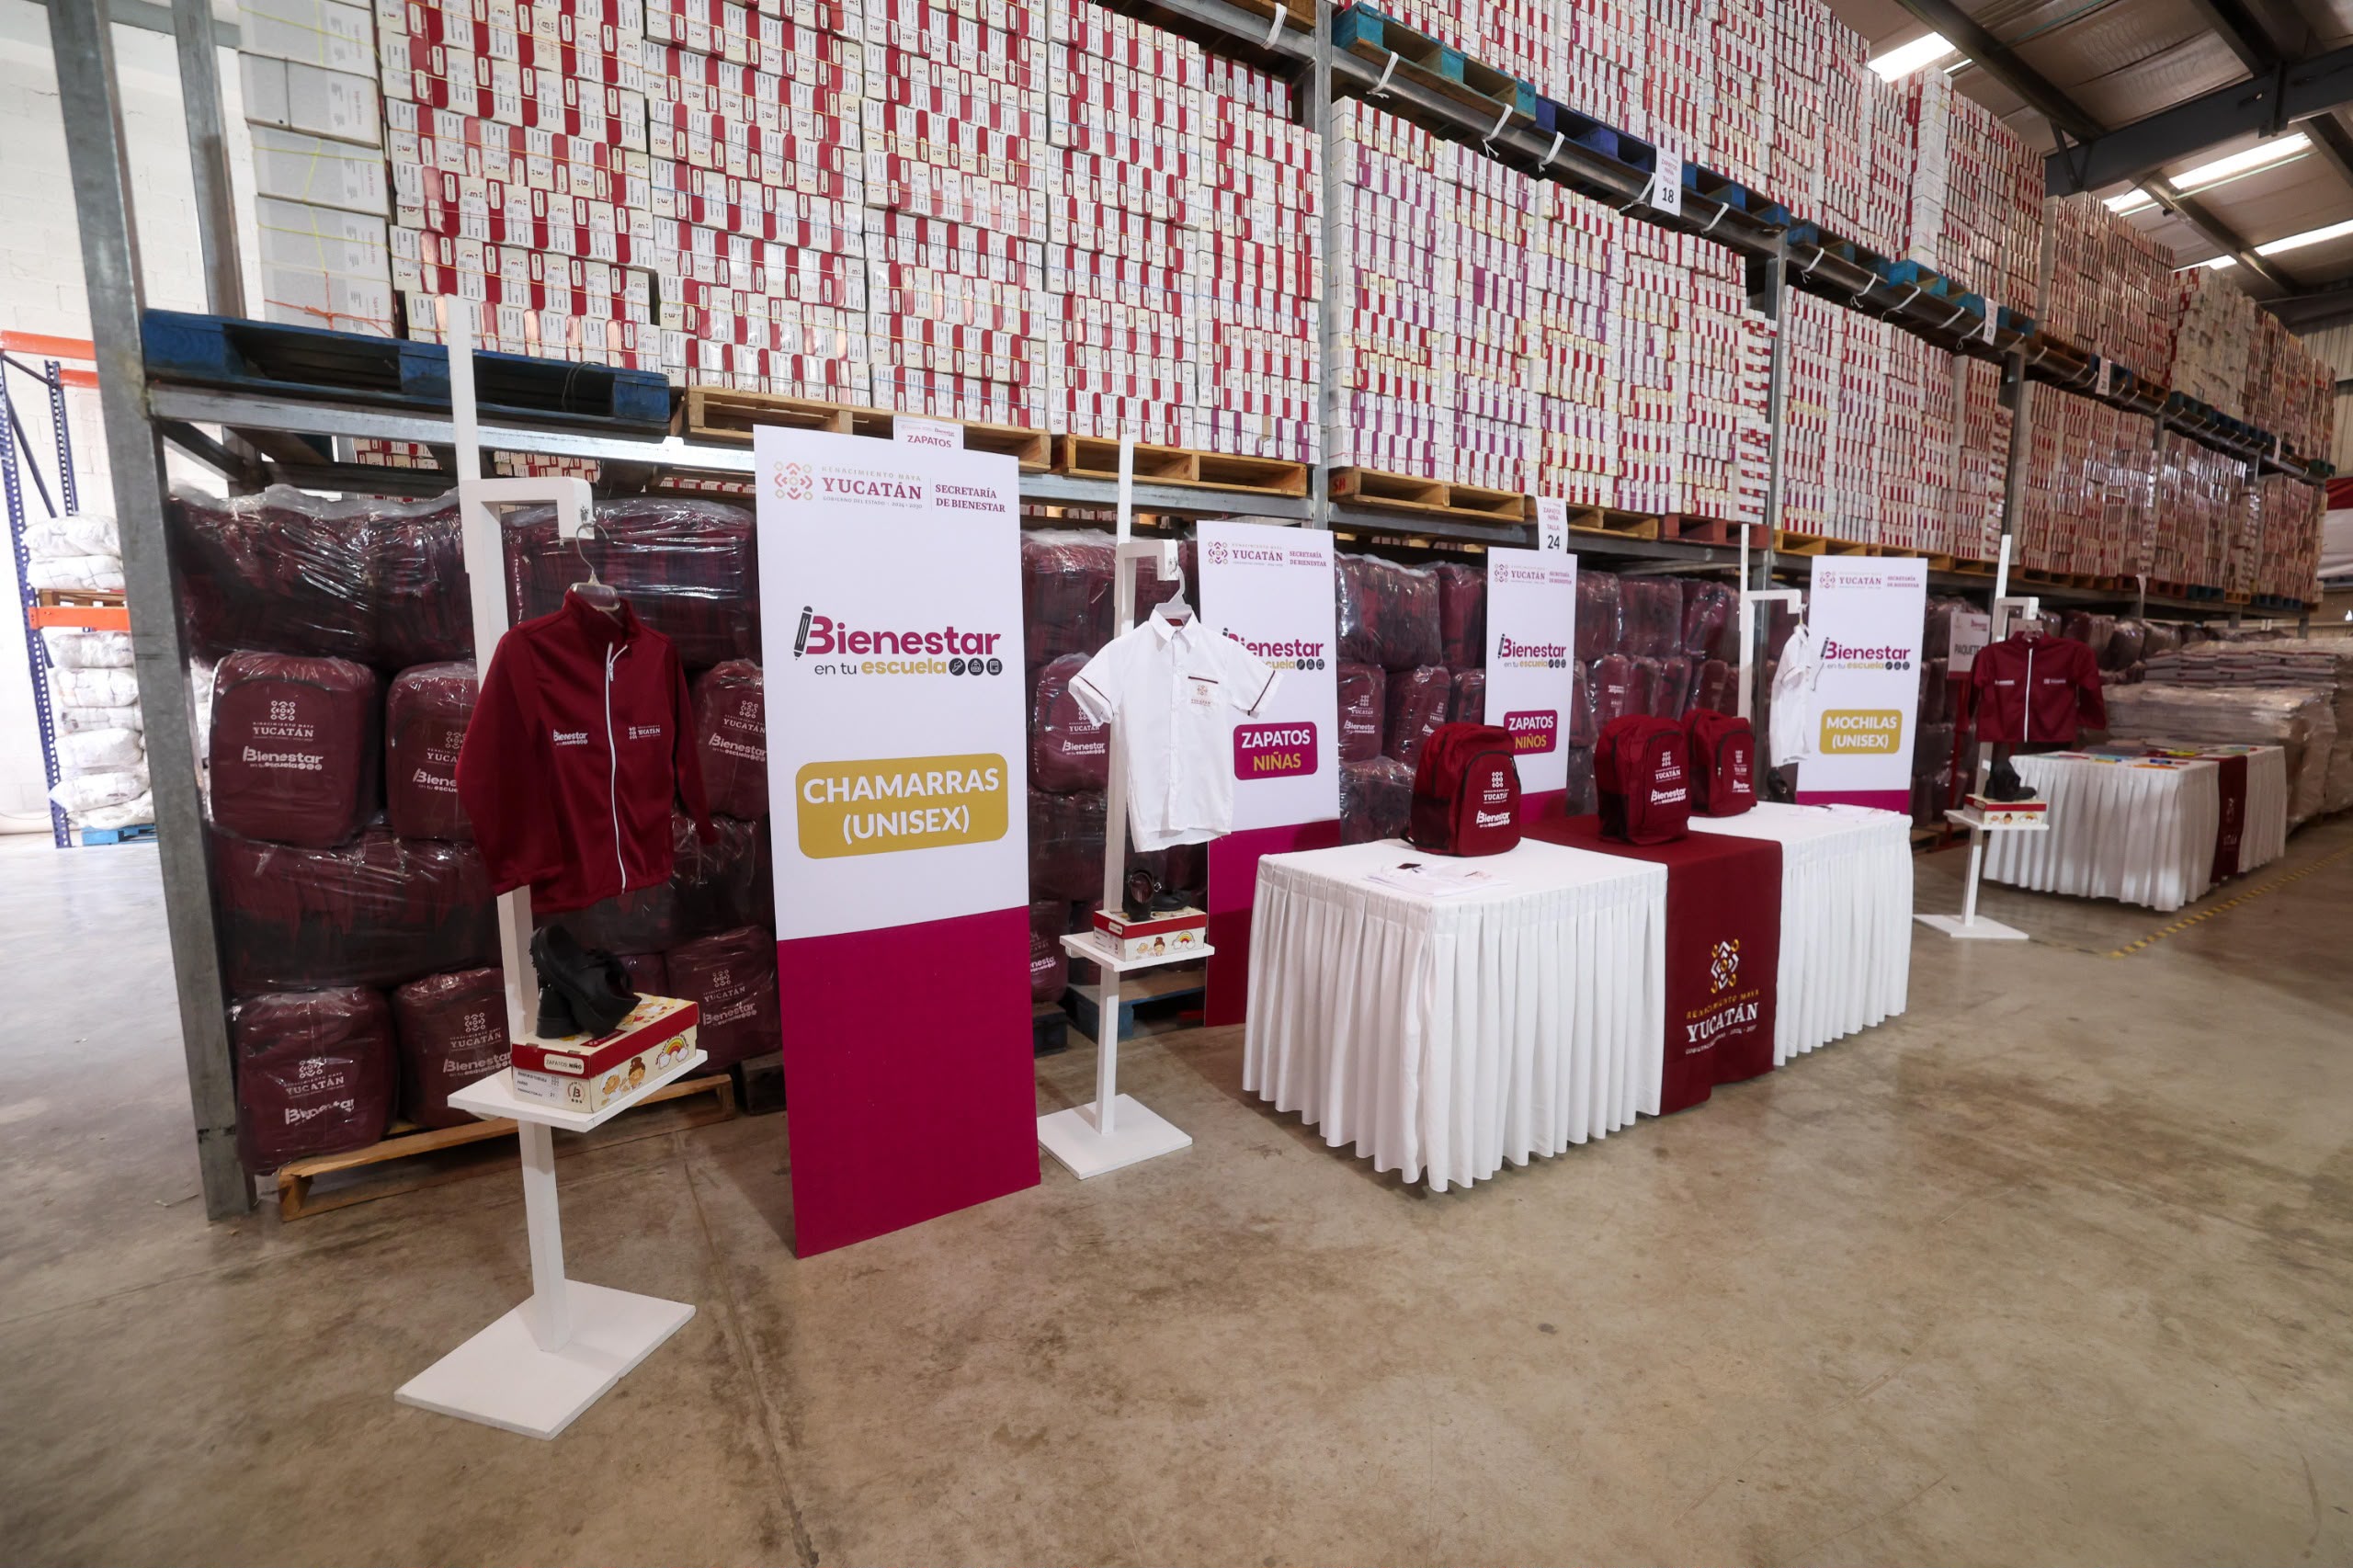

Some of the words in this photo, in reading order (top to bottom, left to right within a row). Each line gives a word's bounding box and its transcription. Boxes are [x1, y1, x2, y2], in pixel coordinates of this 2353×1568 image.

[1662, 187, 1674, 203] 18
[907, 435, 951, 448] ZAPATOS
[822, 466, 894, 479] RENACIMIENTO
[822, 477, 922, 499] YUCATÁN
[935, 483, 996, 499] SECRETARÍA
[936, 497, 949, 507] DE
[951, 499, 1006, 513] BIENESTAR
[1548, 535, 1560, 550] 24
[1233, 550, 1283, 561] YUCATÁN
[800, 610, 1001, 656] Bienestar
[1228, 633, 1324, 657] enestar
[1500, 635, 1566, 658] Bienestar
[1823, 639, 1910, 660] Bienestar
[814, 662, 835, 675] en
[840, 660, 857, 675] tu
[861, 658, 947, 675] escuela
[1519, 659, 1548, 667] escuela
[1847, 662, 1884, 670] escuela
[1508, 716, 1553, 731] ZAPATOS
[1825, 716, 1897, 729] MOCHILAS
[253, 726, 313, 737] YUCATÁN
[553, 730, 588, 741] Bienestar
[1242, 729, 1311, 749] ZAPATOS
[709, 733, 766, 756] Bienestar
[1063, 739, 1105, 752] Bienestar
[1515, 733, 1547, 749] NIÑOS
[1832, 733, 1889, 749] (UNISEX)
[243, 745, 324, 764] Bienestar
[427, 752, 458, 763] YUCA
[1253, 751, 1302, 771] NIÑAS
[413, 767, 457, 787] Biene
[802, 767, 999, 804] CHAMARRAS
[1651, 788, 1687, 802] Bienestar
[843, 804, 970, 846] (UNISEX)
[1686, 1002, 1758, 1042] YUCATÁN
[449, 1031, 502, 1048] YUCATÁN
[443, 1051, 511, 1073] Bienestar
[546, 1059, 567, 1067] ZAPATOS
[286, 1076, 344, 1095] YUCATÁN
